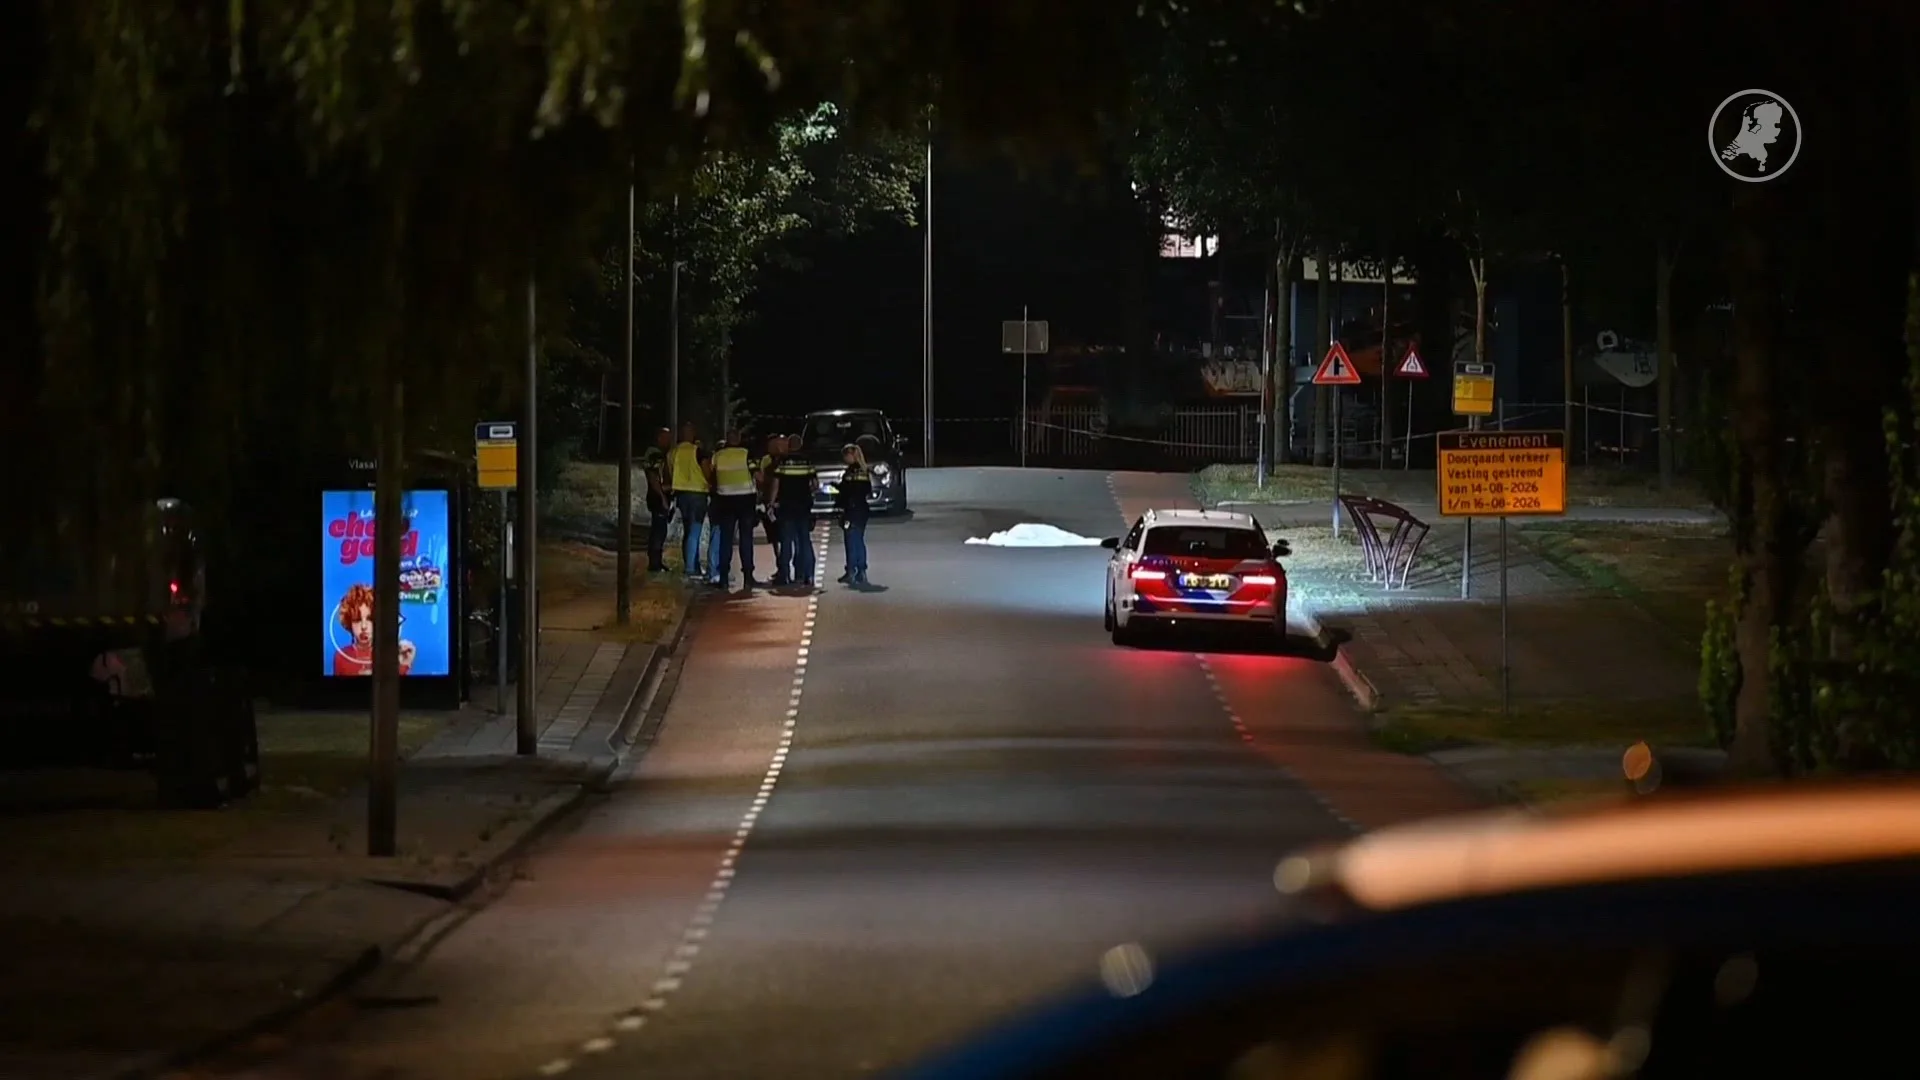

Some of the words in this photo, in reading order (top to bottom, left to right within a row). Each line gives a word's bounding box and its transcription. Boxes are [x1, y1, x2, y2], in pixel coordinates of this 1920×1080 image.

[1458, 434, 1549, 448] Evenement
[1447, 453, 1505, 466] Doorgaand
[1509, 453, 1550, 463] verkeer
[1447, 468, 1489, 480] Vesting
[1492, 467, 1543, 480] gestremd
[1448, 485, 1468, 494] van
[1471, 483, 1538, 494] 14-08-2026
[1448, 498, 1470, 509] t/m
[1473, 497, 1541, 509] 16-08-2026
[340, 531, 419, 566] god
